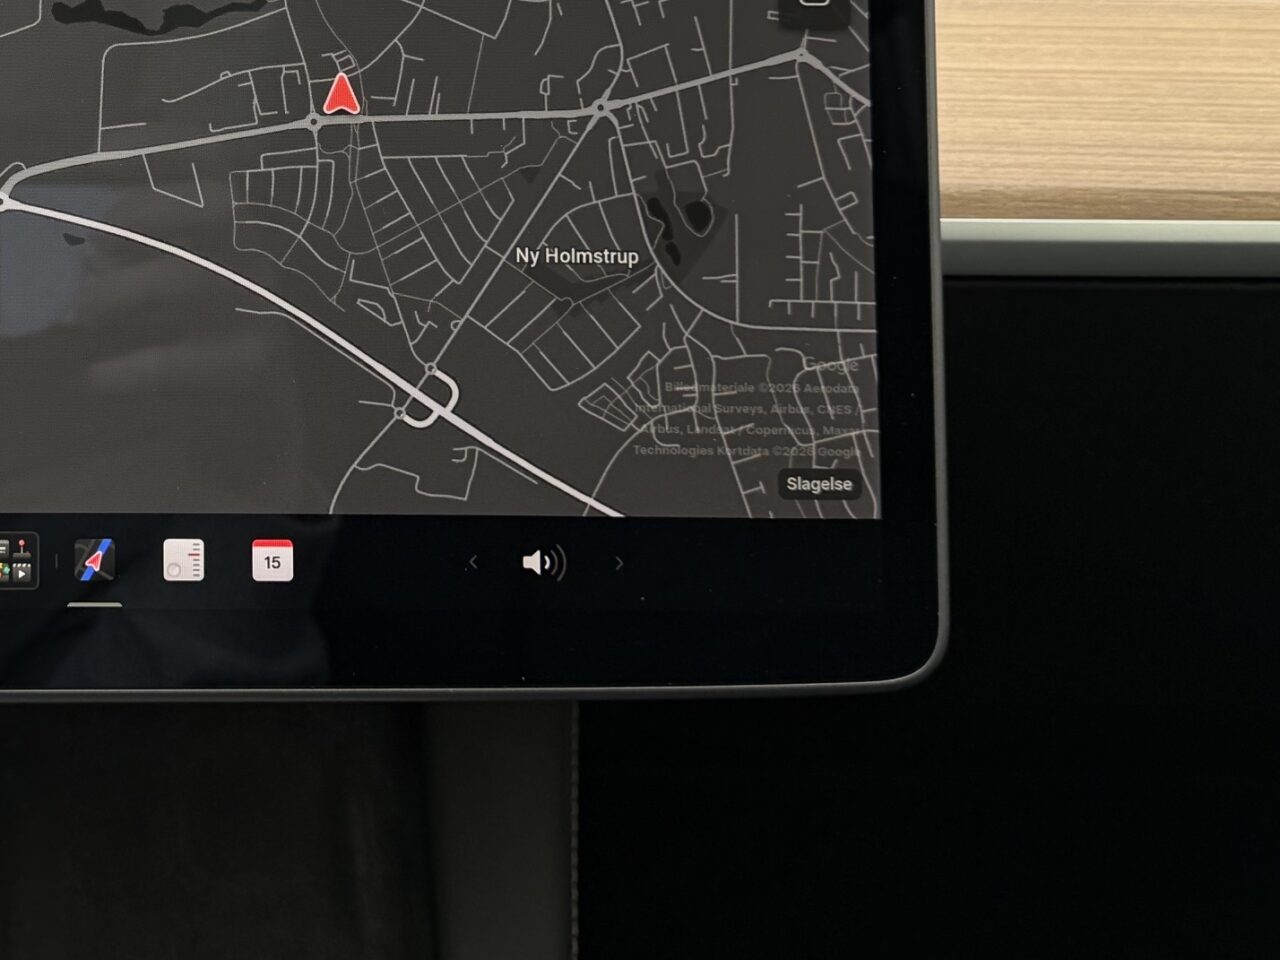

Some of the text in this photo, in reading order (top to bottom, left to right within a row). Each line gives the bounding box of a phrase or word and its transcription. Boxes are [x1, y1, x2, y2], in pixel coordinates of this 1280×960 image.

[516, 247, 639, 268] Ny Holmstrup
[787, 477, 853, 494] Slagelse
[264, 555, 281, 569] 15
